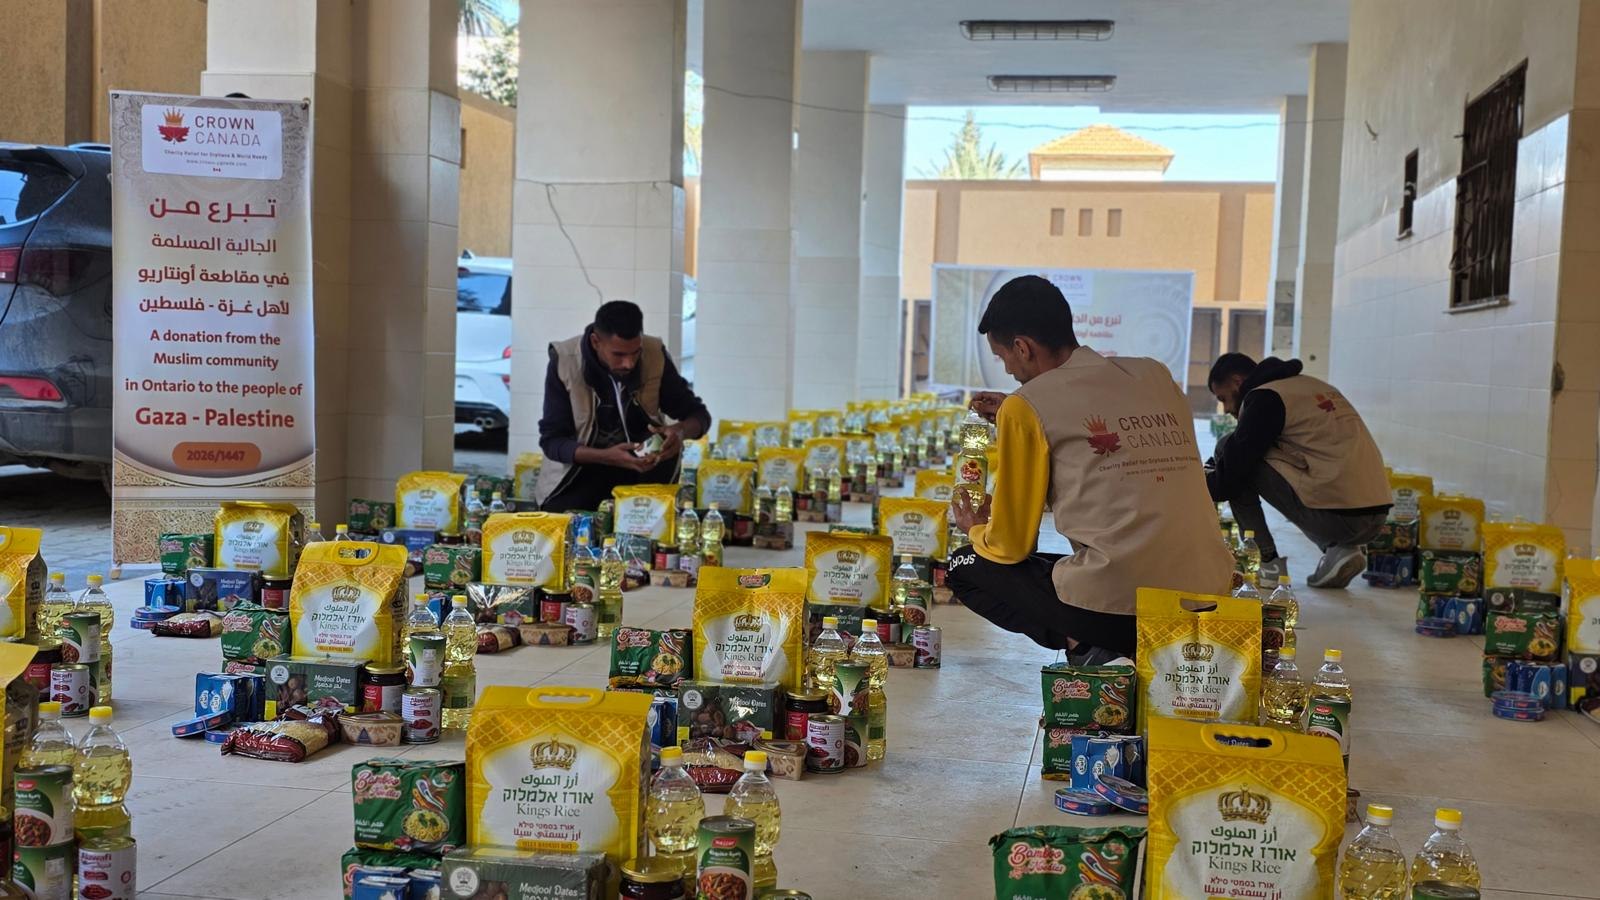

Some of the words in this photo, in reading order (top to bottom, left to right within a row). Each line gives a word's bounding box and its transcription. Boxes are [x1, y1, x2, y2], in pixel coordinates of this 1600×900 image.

[195, 116, 255, 130] CROWN
[195, 131, 261, 146] CANADA
[150, 198, 200, 219] من
[208, 199, 277, 223] تبرع
[152, 233, 221, 251] المسلمة
[226, 238, 276, 256] الجالية
[138, 264, 195, 285] أونتاريو
[199, 268, 260, 285] مقاطعة
[263, 272, 289, 288] في
[139, 296, 205, 313] فلسطين
[218, 299, 253, 316] غزة
[257, 300, 289, 317] لأهل
[150, 330, 160, 341] A
[163, 330, 222, 343] donation
[225, 331, 256, 344] from
[260, 333, 280, 345] the
[153, 352, 203, 365] Muslim
[206, 355, 279, 371] community
[125, 378, 138, 391] in
[142, 379, 195, 393] Ontario
[199, 381, 212, 394] to
[216, 381, 238, 394] the
[242, 382, 286, 398] people
[289, 383, 303, 396] of
[135, 407, 187, 425] Gaza
[205, 408, 295, 428] Palestine
[1118, 412, 1179, 431] CROWN
[1127, 430, 1192, 449] CANADA
[186, 449, 245, 461] 2026/1447
[948, 554, 976, 571] SPORT
[324, 604, 348, 613] الملوك
[311, 612, 345, 621] אלמלוק
[348, 615, 366, 624] אורז
[728, 634, 753, 643] الملوك
[715, 643, 751, 652] אלמלוק
[1176, 664, 1205, 674] الملوك
[1207, 663, 1218, 674] أرز
[314, 674, 335, 682] Medjool
[336, 675, 351, 684] Dates
[1165, 673, 1204, 685] אלמלוק
[1207, 676, 1230, 686] אורז
[1175, 683, 1200, 695] Kings
[1202, 685, 1221, 694] Rice
[355, 770, 400, 792] Bamboo
[521, 774, 560, 788] الملوك
[563, 773, 578, 789] أرز
[503, 787, 558, 803] אלמלוק
[563, 791, 594, 804] אורז
[517, 803, 551, 819] Kings
[554, 805, 581, 817] Rice
[1211, 826, 1256, 840] الملوك
[1260, 826, 1277, 844] أرز
[1009, 843, 1062, 866] Bamboo
[1192, 840, 1254, 857] אלמלוק
[1260, 847, 1296, 861] אורז
[1209, 856, 1247, 875] Kings
[1252, 860, 1282, 874] Rice
[1210, 876, 1228, 884] סילא
[1259, 881, 1275, 889] אורז
[519, 882, 551, 894] Medjool
[554, 884, 578, 897] Dates
[1204, 884, 1225, 895] سيلا
[1228, 887, 1267, 898] بسمتي
